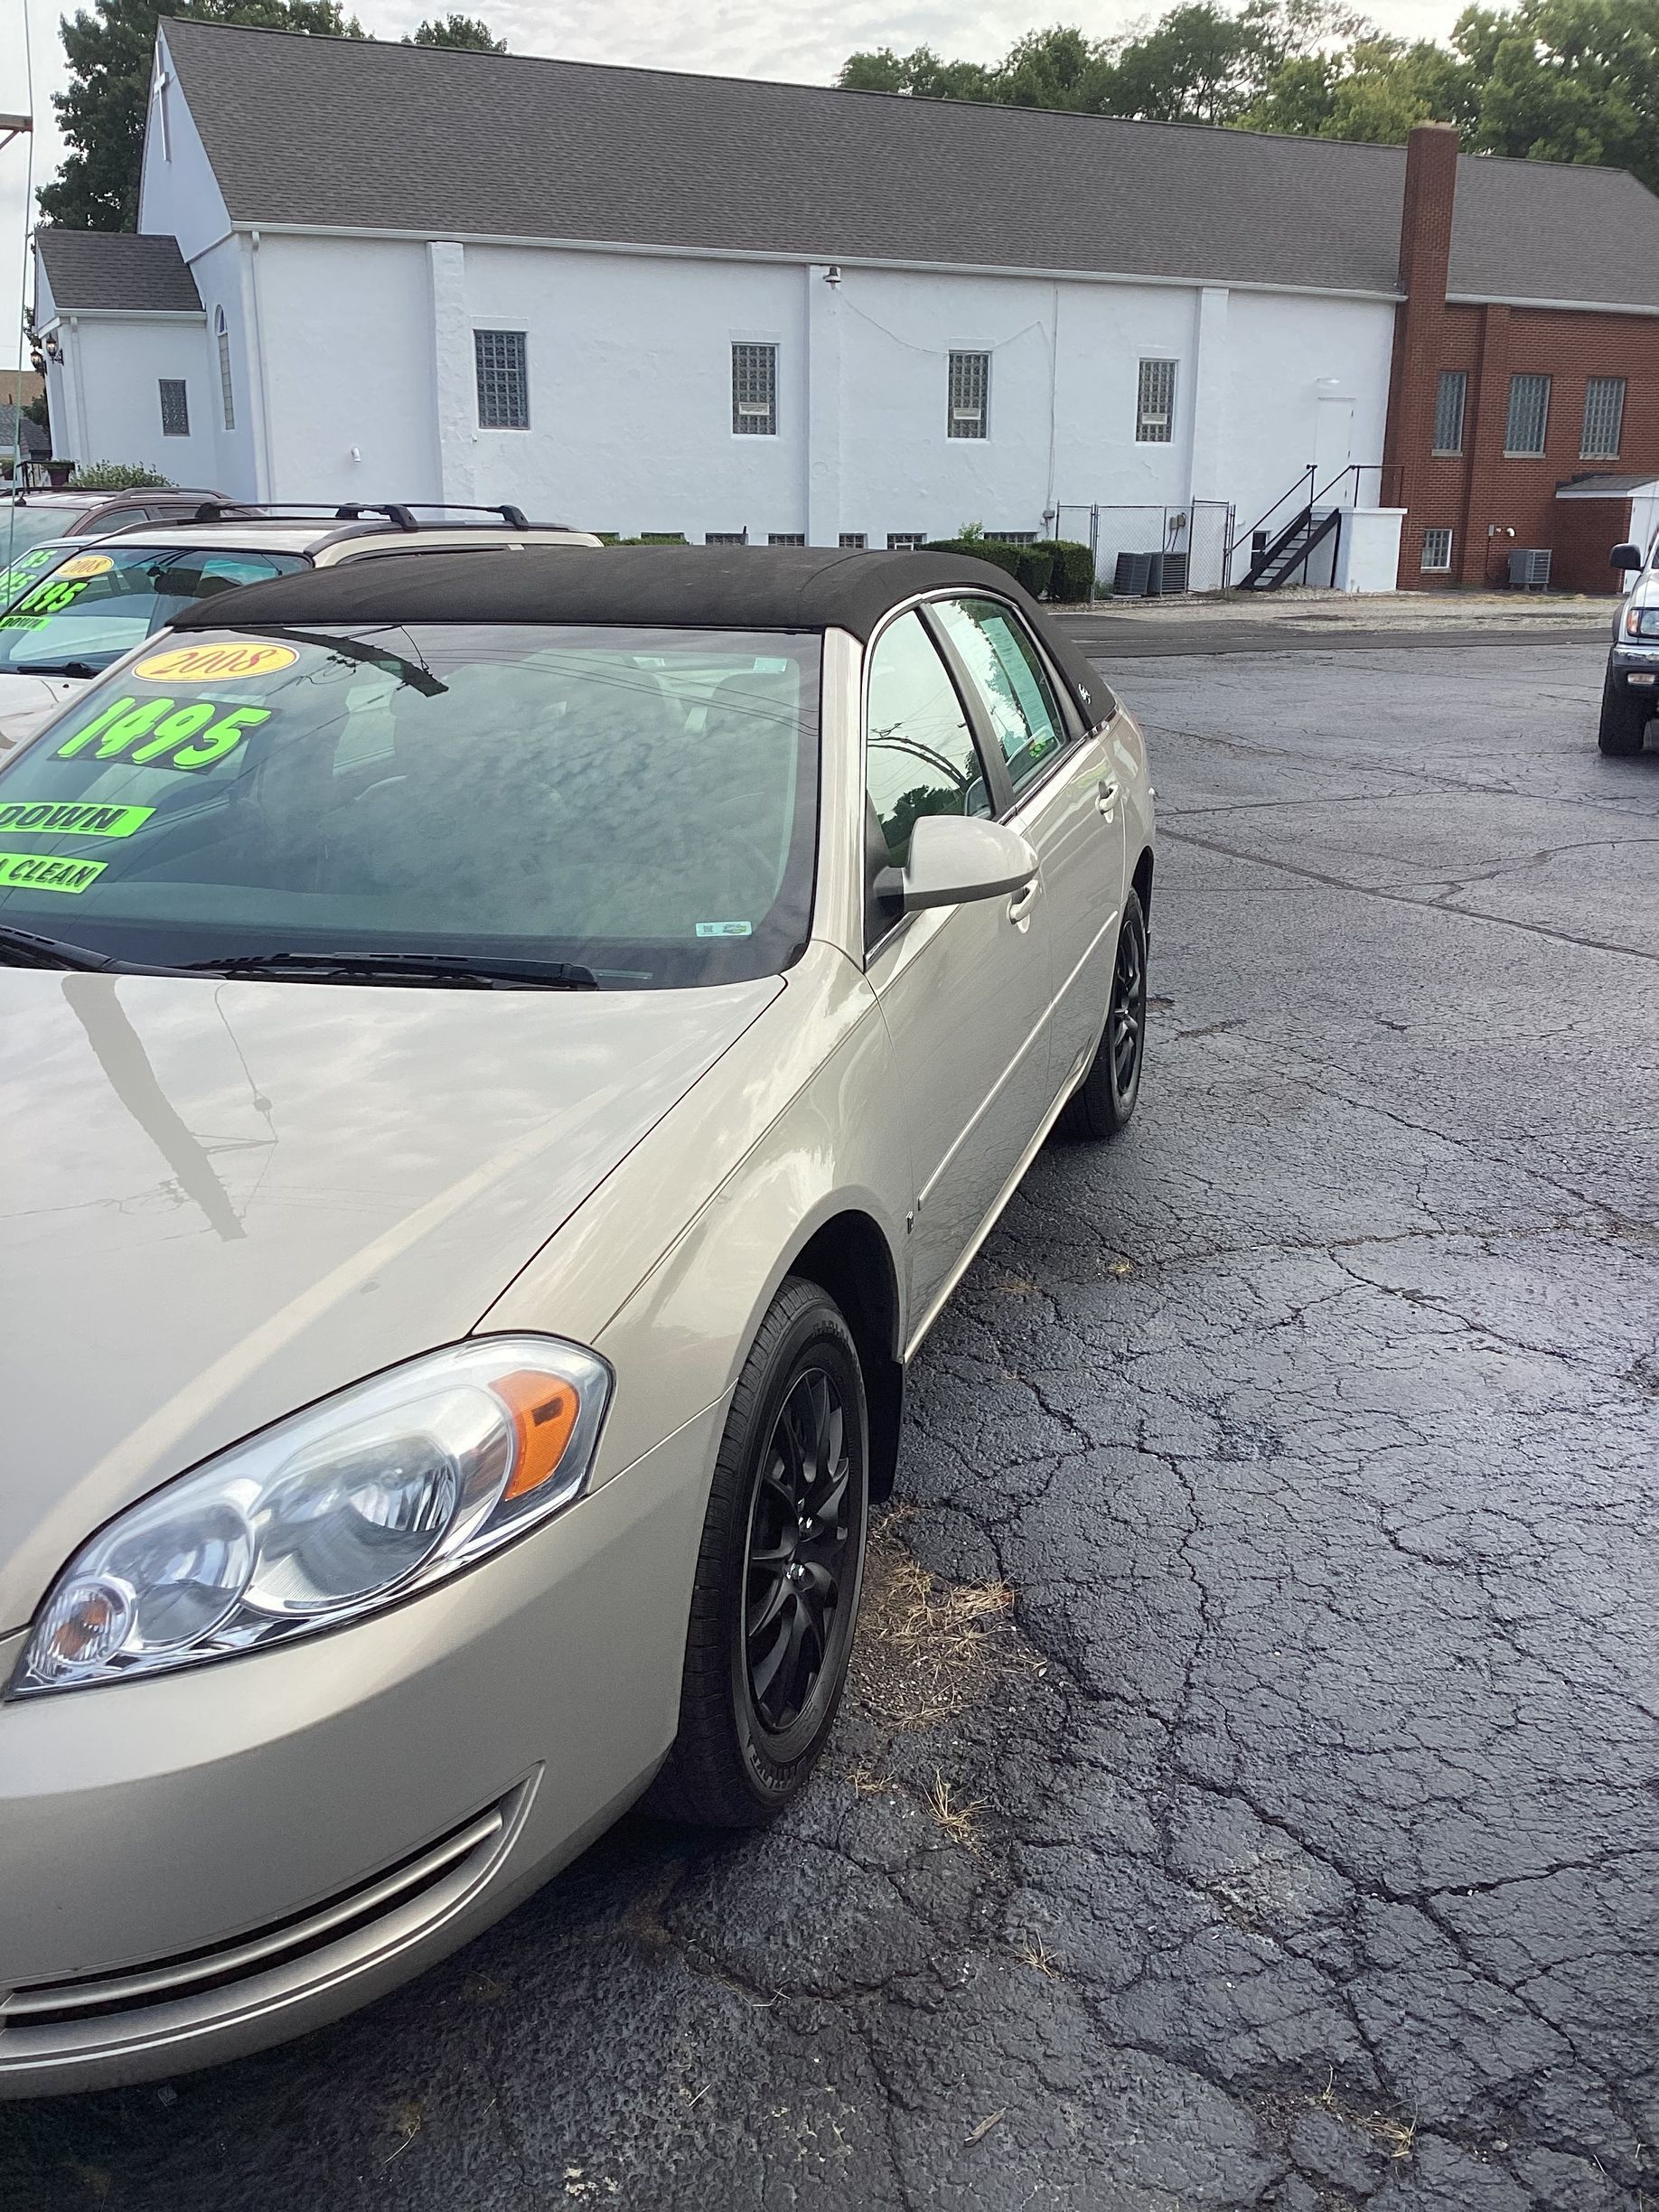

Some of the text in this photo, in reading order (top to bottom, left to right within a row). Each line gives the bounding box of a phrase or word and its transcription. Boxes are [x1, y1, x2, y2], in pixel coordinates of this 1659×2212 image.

[149, 648, 277, 676] 2008
[57, 697, 272, 769] 1495
[0, 805, 129, 832] DOWN
[8, 859, 98, 887] CLEAN
